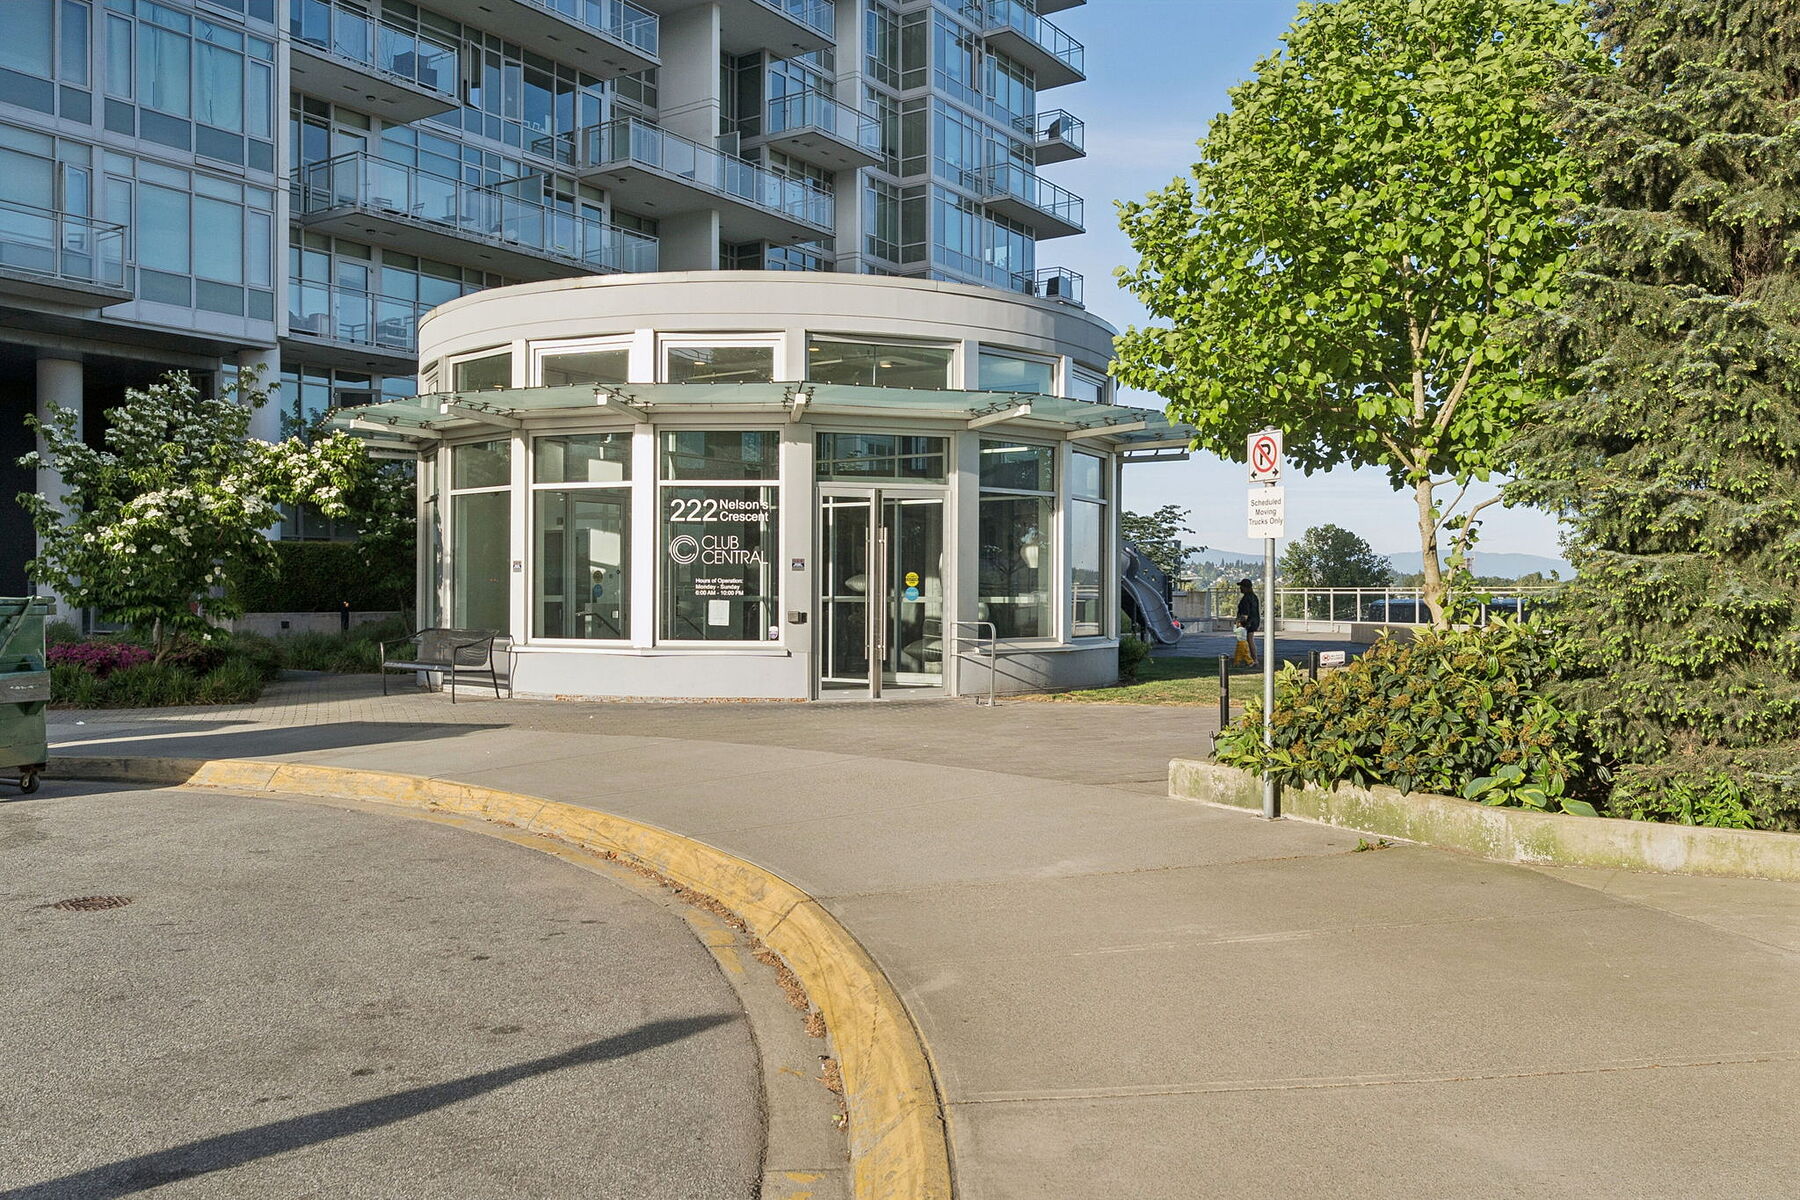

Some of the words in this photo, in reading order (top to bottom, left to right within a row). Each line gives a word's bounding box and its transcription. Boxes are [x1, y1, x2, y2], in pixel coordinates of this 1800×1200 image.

[1250, 498, 1282, 507] Scheduled
[670, 498, 718, 522] 222
[719, 499, 769, 510] Nelson's
[1255, 508, 1277, 517] Moving
[719, 511, 769, 522] Crescent
[1249, 518, 1268, 526] Trucks
[1269, 517, 1284, 526] Only
[701, 534, 740, 550] CLUB
[701, 550, 769, 565] CENTRAL
